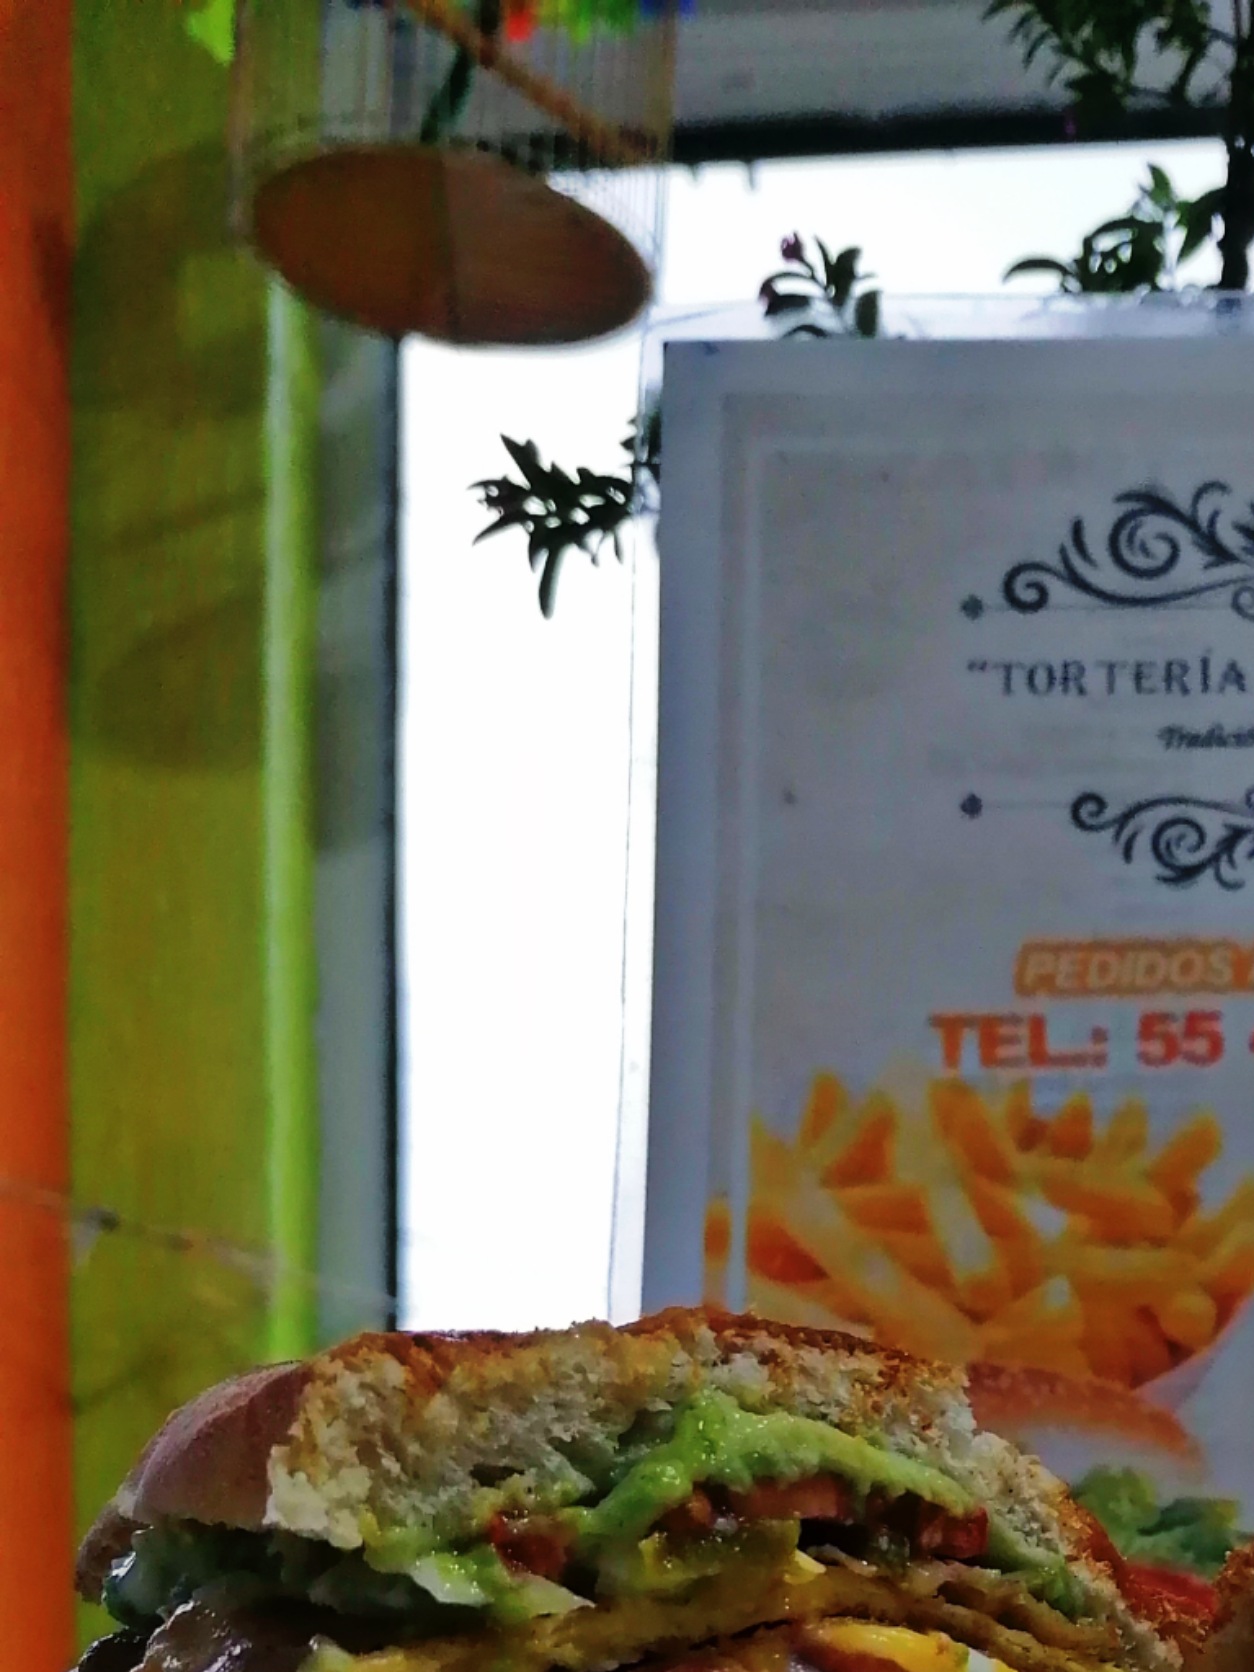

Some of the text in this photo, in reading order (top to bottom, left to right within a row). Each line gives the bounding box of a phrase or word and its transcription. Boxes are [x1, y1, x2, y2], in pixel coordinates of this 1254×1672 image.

[1024, 949, 1233, 993] PEDIDOS
[929, 1013, 1108, 1068] TEL.:
[1136, 1009, 1224, 1066] 55
